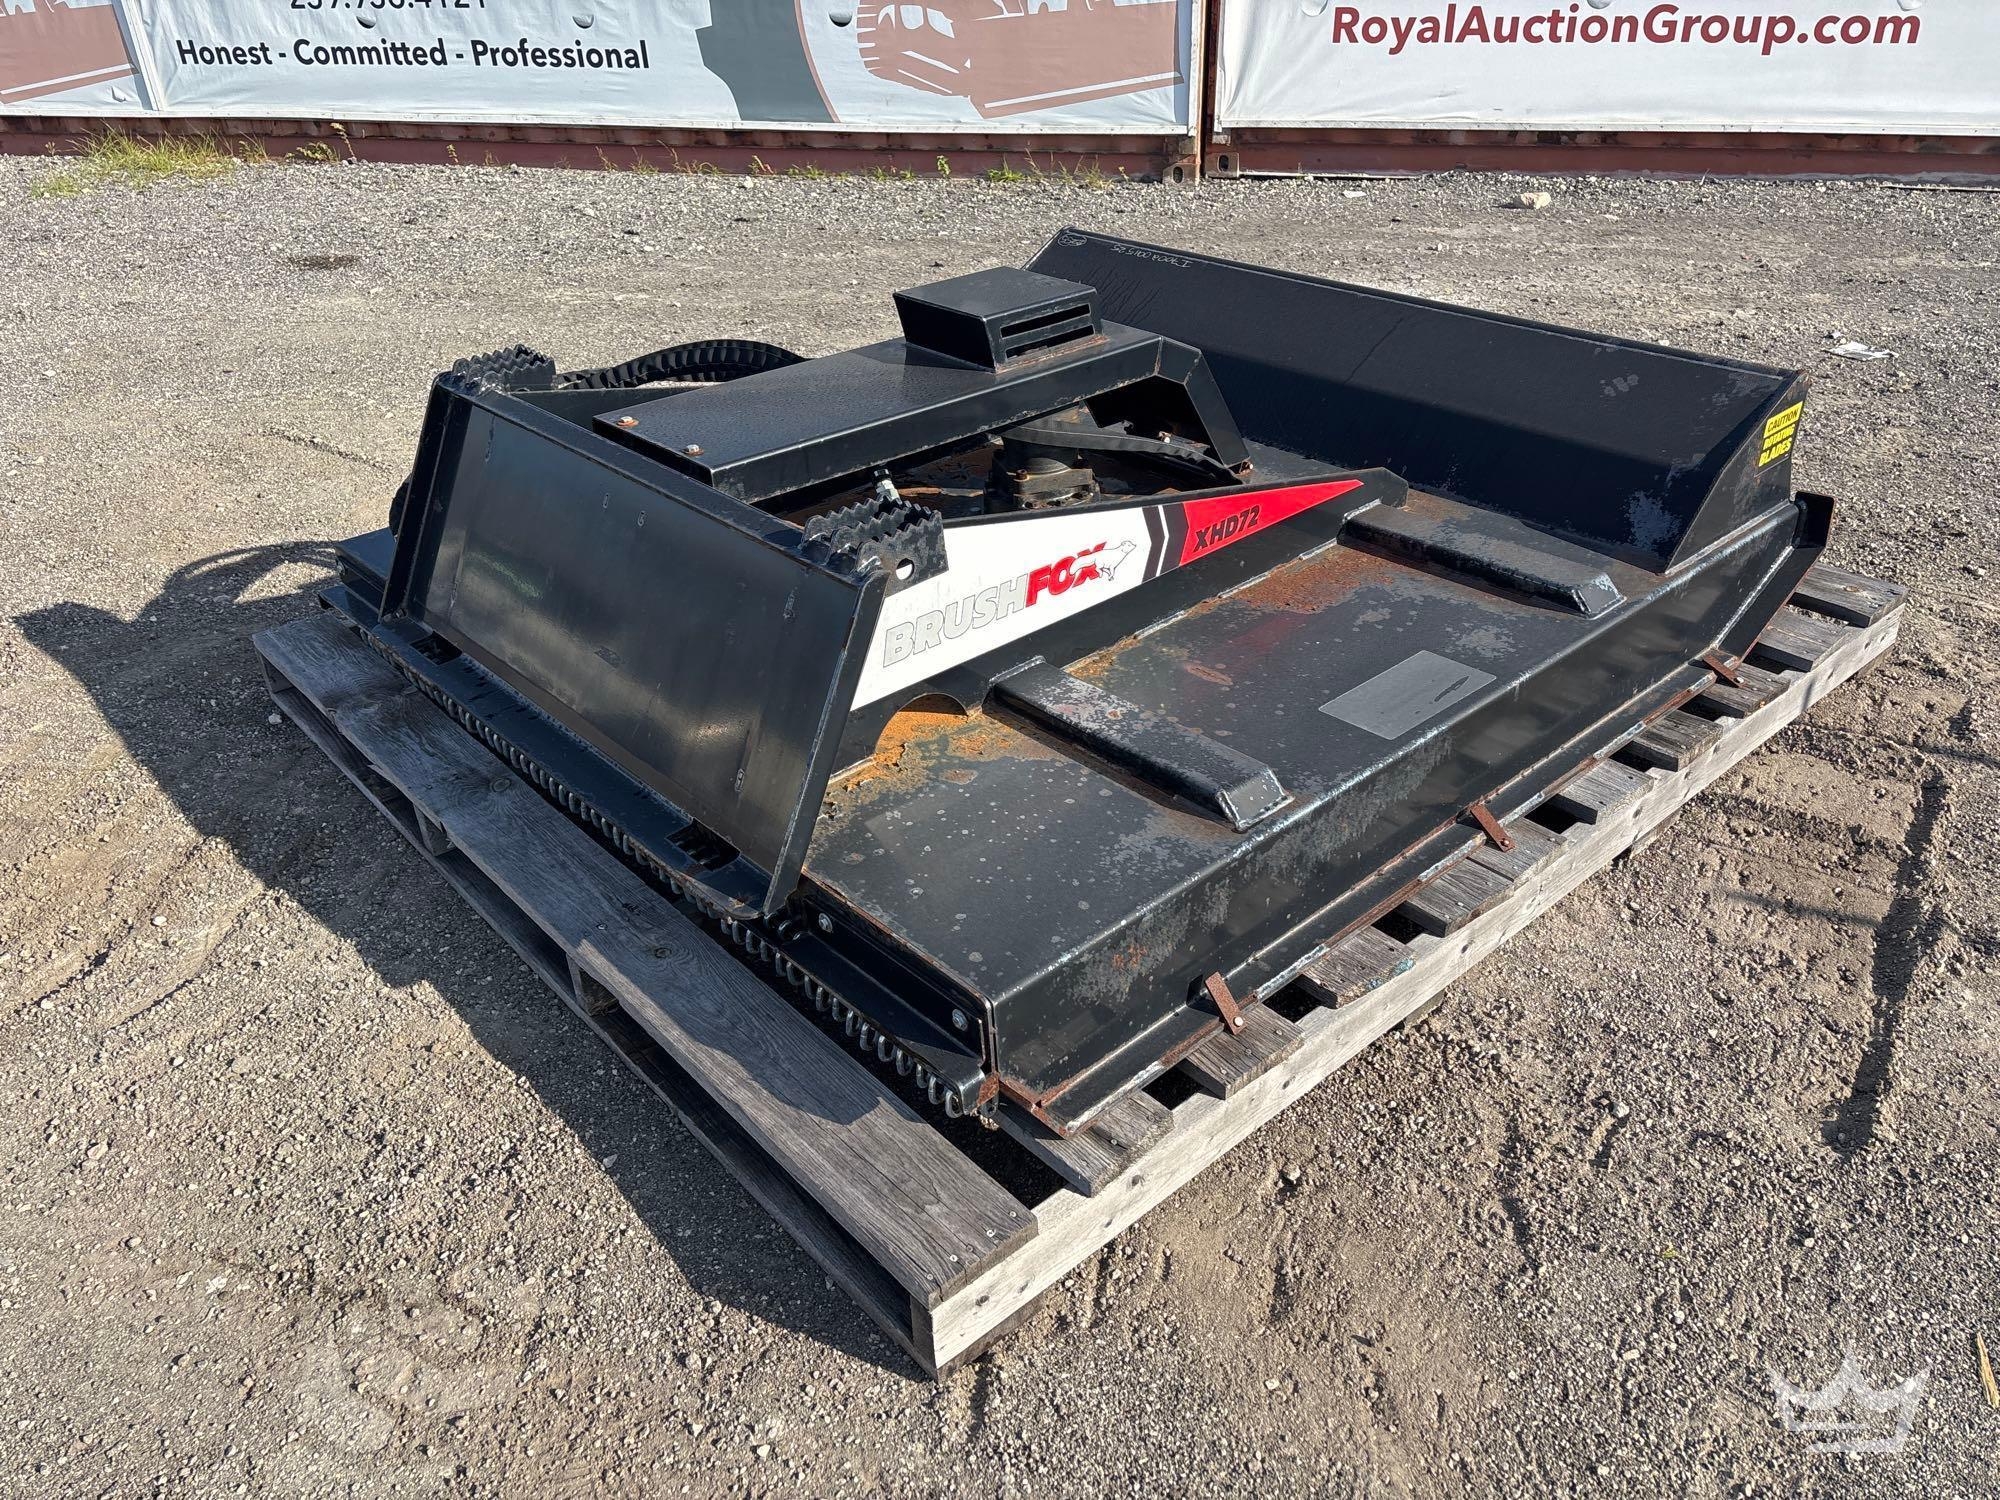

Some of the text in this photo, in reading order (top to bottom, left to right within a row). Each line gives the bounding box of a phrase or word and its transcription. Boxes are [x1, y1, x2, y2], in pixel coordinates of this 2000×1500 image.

[1331, 3, 1921, 56] RoyalAuctionGroup.com
[176, 39, 273, 66] Honest
[293, 37, 448, 66] Committed
[470, 37, 650, 69] Professional
[1767, 408, 1799, 433] CAUTION
[1758, 437, 1793, 468] BLADES
[1192, 504, 1261, 554] XHD72
[882, 540, 1108, 669] BRUSHFOX
